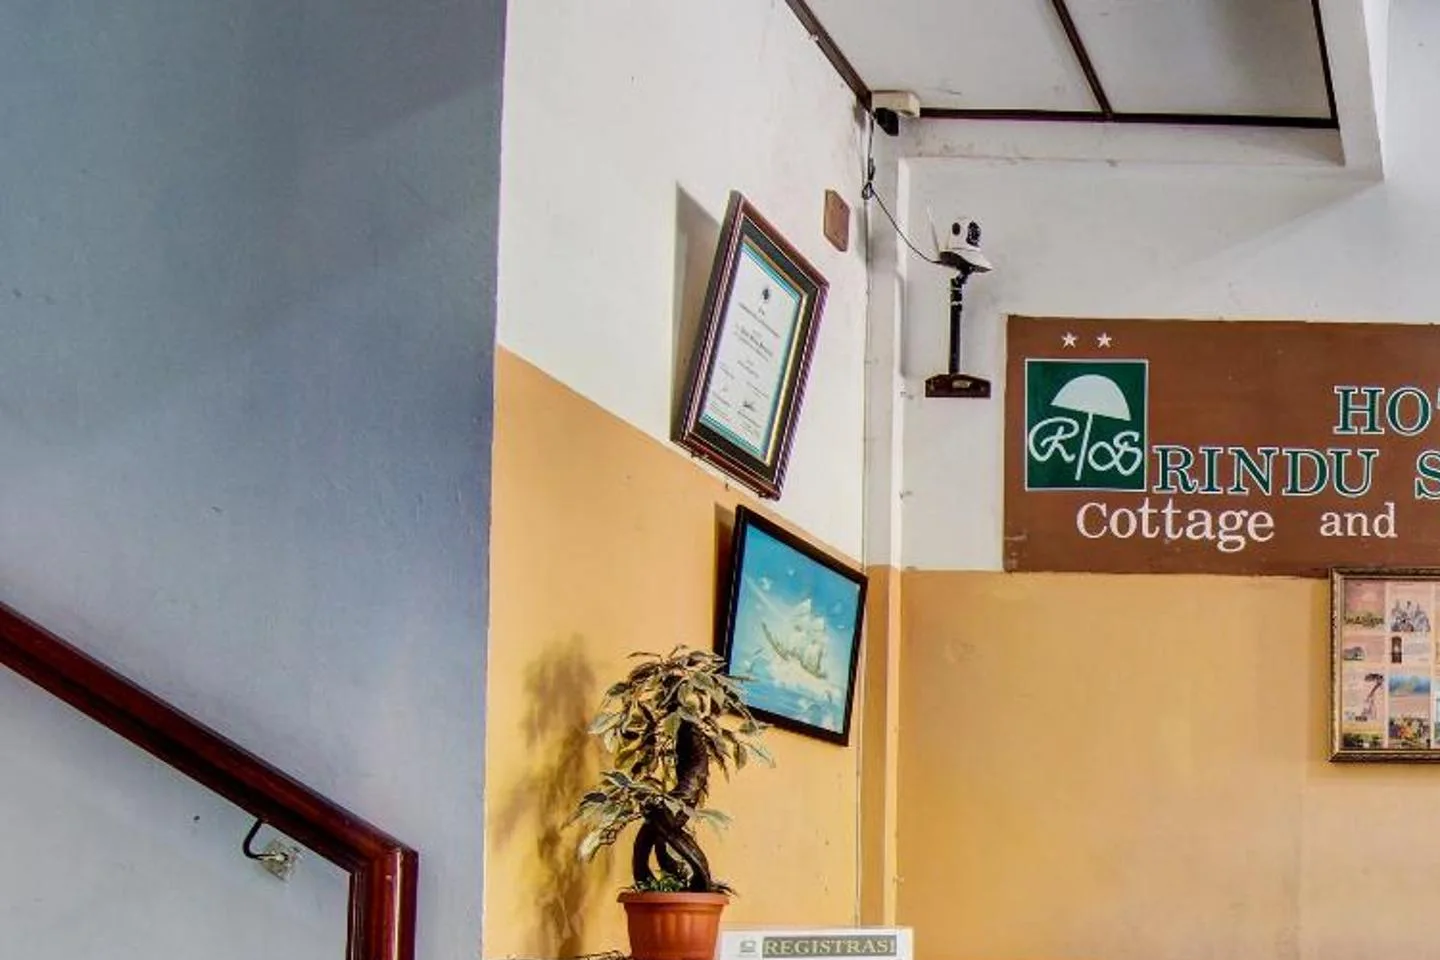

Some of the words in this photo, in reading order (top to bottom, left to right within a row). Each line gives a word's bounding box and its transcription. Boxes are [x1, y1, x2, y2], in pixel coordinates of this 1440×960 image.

[1152, 445, 1379, 497] RINDU
[1076, 497, 1275, 552] Cottage
[1319, 502, 1398, 539] and
[764, 939, 895, 954] REGISTRASI
